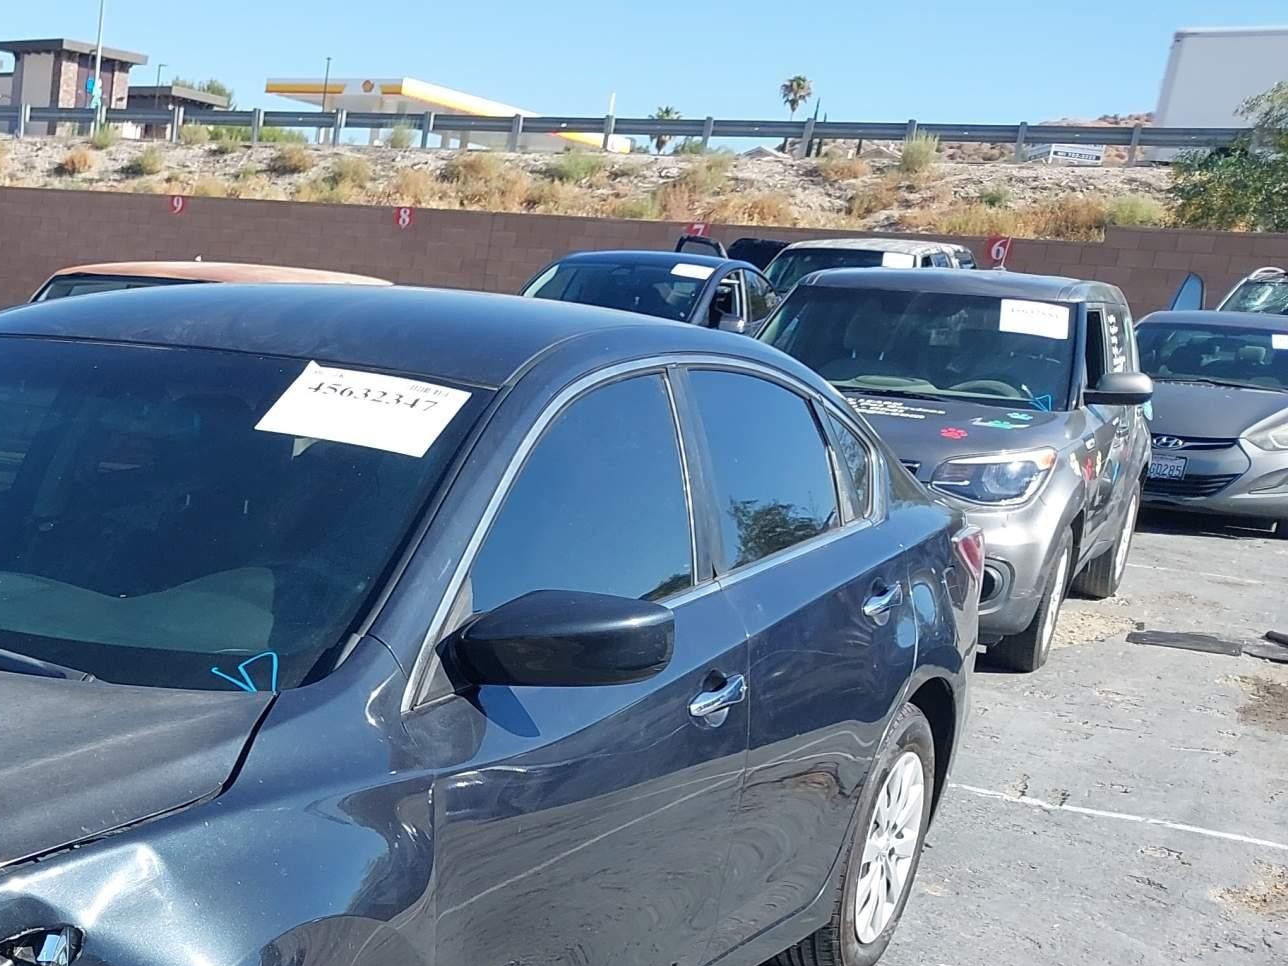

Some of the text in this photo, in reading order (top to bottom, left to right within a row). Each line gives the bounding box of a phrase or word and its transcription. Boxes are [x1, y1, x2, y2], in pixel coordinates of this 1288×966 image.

[172, 196, 183, 213] 9
[398, 207, 410, 227] 8
[692, 223, 706, 236] 7
[990, 239, 1008, 260] 6
[307, 381, 439, 412] 45632347
